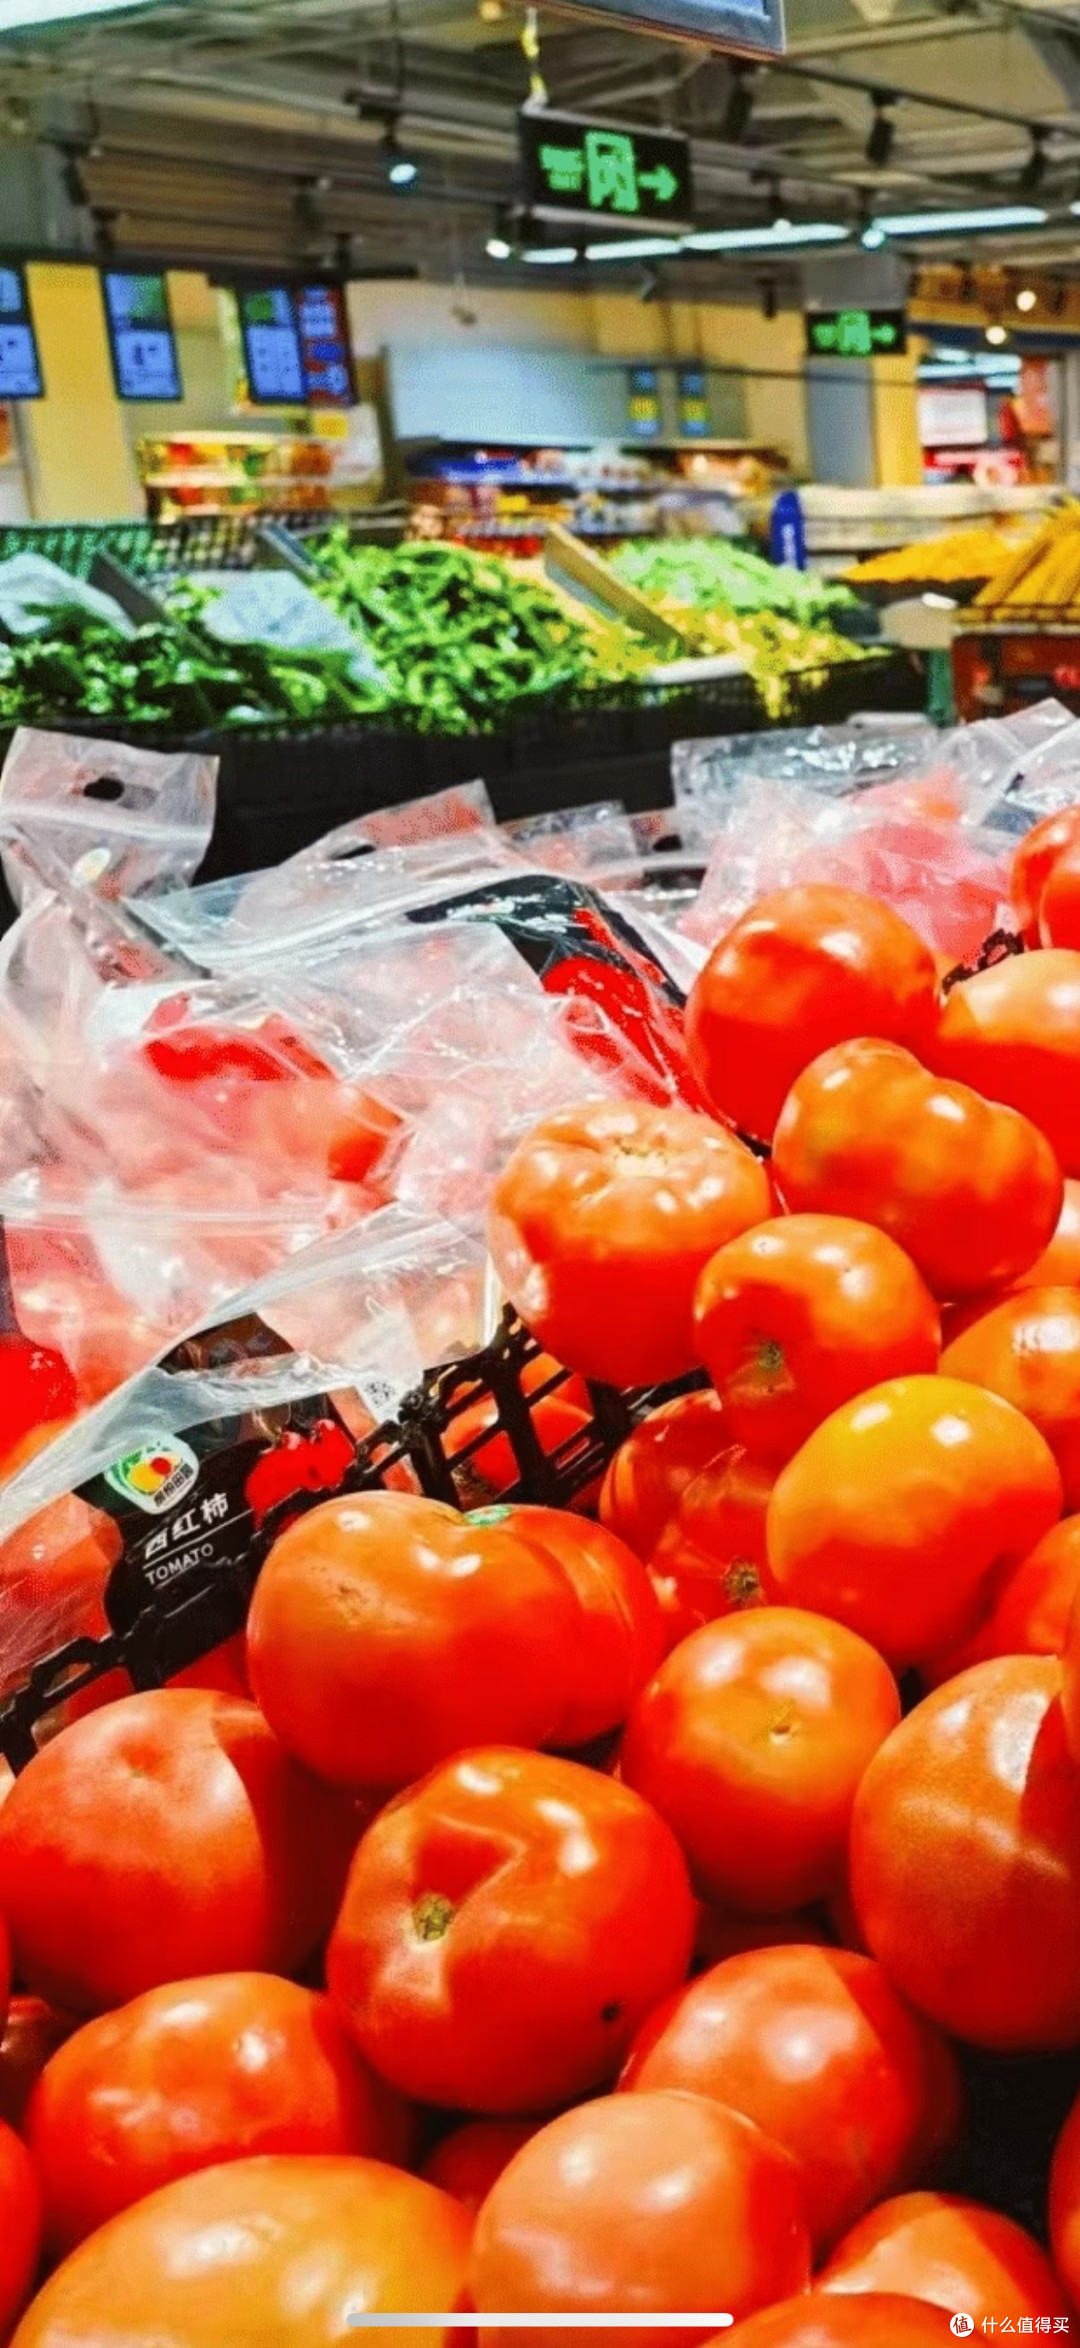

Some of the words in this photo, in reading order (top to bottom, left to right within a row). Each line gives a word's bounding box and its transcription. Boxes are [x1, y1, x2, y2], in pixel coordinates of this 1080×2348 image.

[144, 1492, 229, 1560] 西红柿
[144, 1543, 214, 1585] TOMATO
